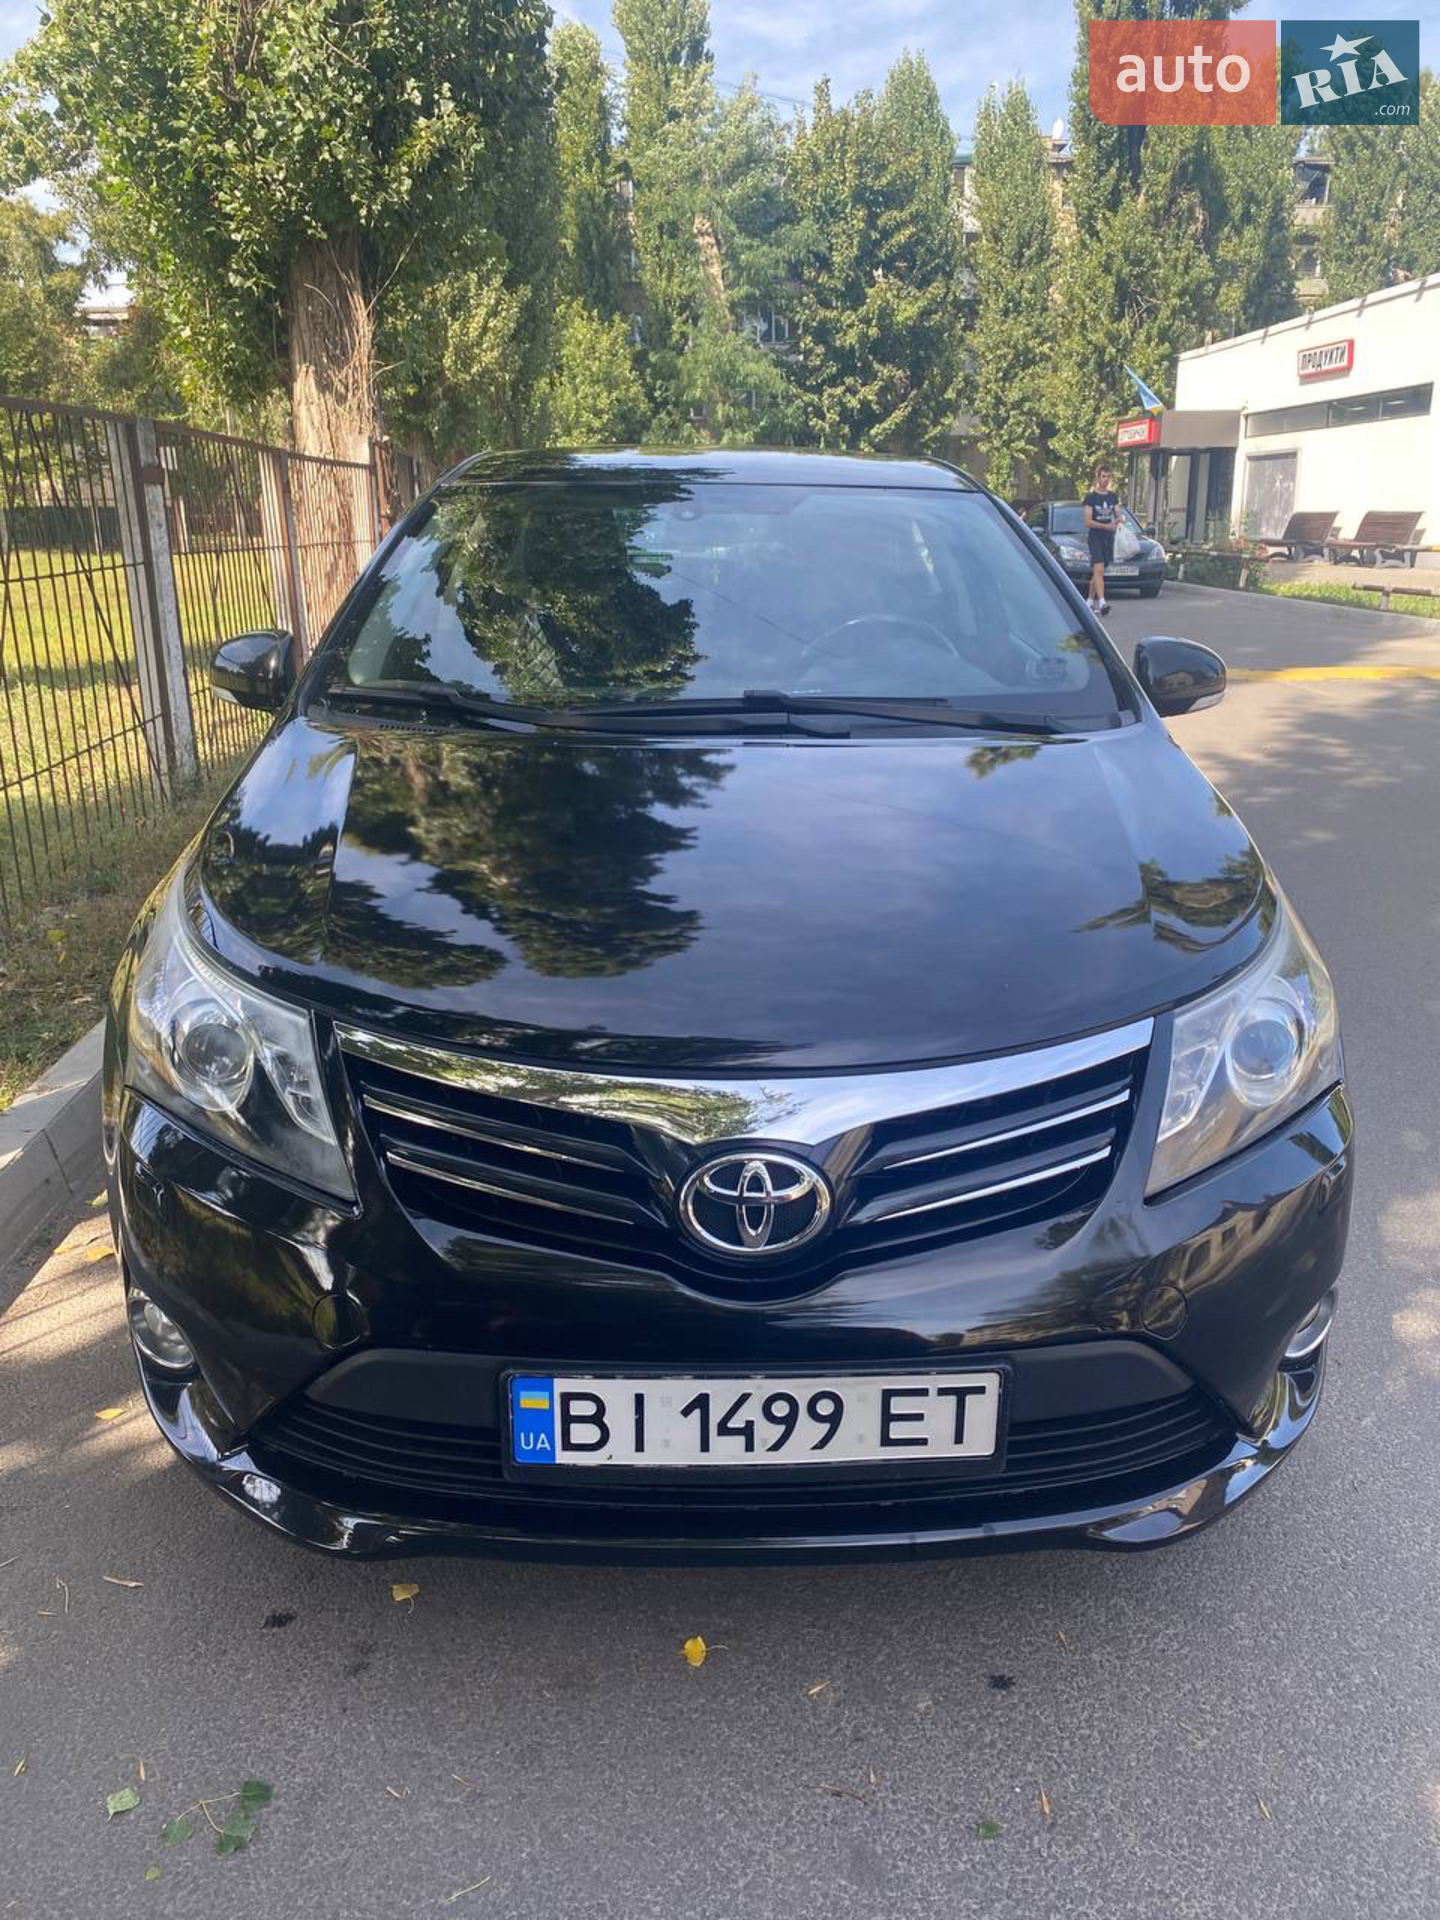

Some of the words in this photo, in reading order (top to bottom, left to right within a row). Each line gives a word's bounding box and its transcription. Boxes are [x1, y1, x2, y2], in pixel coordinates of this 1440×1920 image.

[1300, 345, 1346, 371] ПРОДУКТИ
[559, 1391, 645, 1453] BI
[680, 1391, 844, 1453] 1499
[880, 1385, 987, 1447] ET
[521, 1433, 551, 1451] UA
